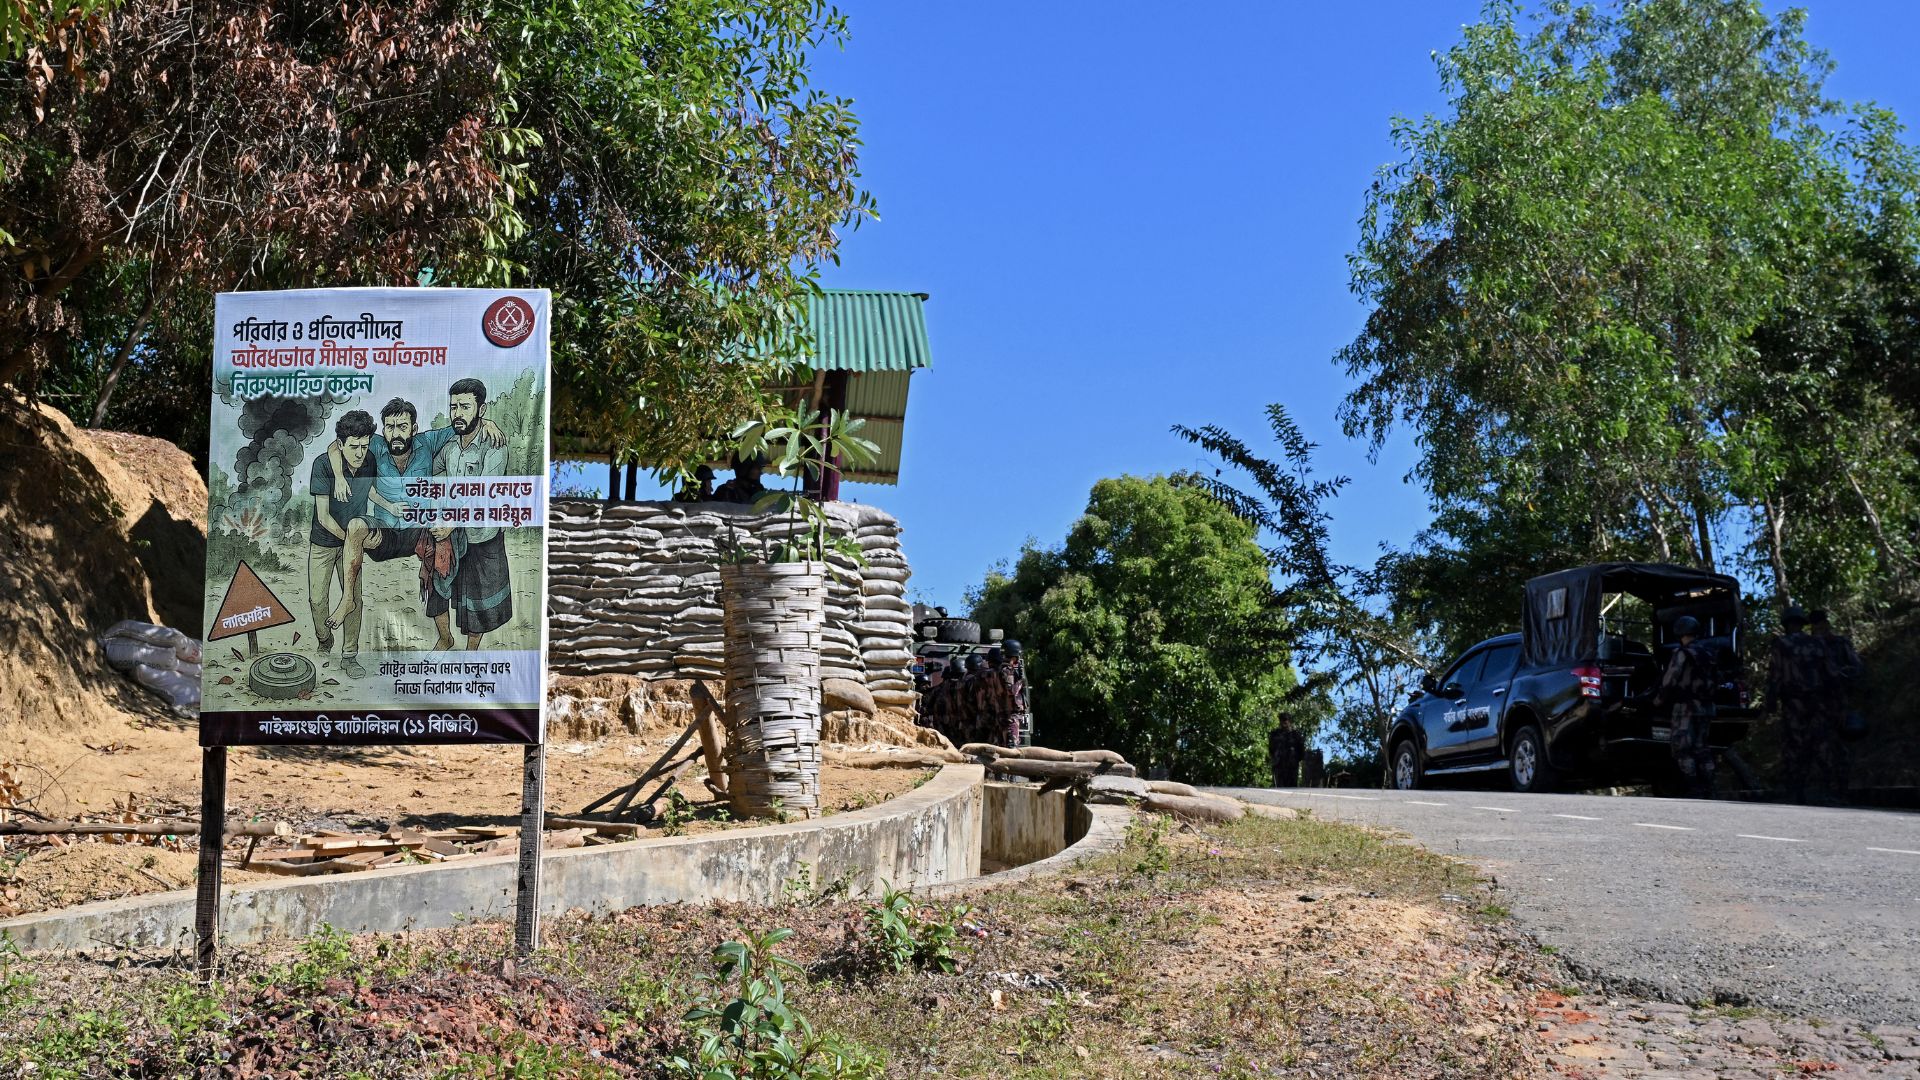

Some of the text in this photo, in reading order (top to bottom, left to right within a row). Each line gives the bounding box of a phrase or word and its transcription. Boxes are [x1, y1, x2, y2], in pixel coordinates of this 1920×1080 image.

[233, 313, 403, 343] পরিবার ও প্রতিবেশীদের
[231, 340, 448, 370] অবৈধভাবে সীমান্ত অতিক্রমে
[229, 369, 374, 398] নিরুৎসাহিত করুন
[449, 482, 485, 500] বোমা
[488, 482, 533, 499] ফোডে
[402, 501, 532, 527] অঁডে আর ন যাইয়ুম
[222, 606, 271, 629] ল্যান্ডমাইন
[379, 660, 511, 678] রাষ্ট্রের আইন মেনে চলুন এবং
[394, 679, 496, 698] নিজে নিরাপদে থাকুন
[258, 713, 479, 738] নাইক্ষ্যংছড়ি ব্যাটালিয়ন (১১ বিজিবি)
